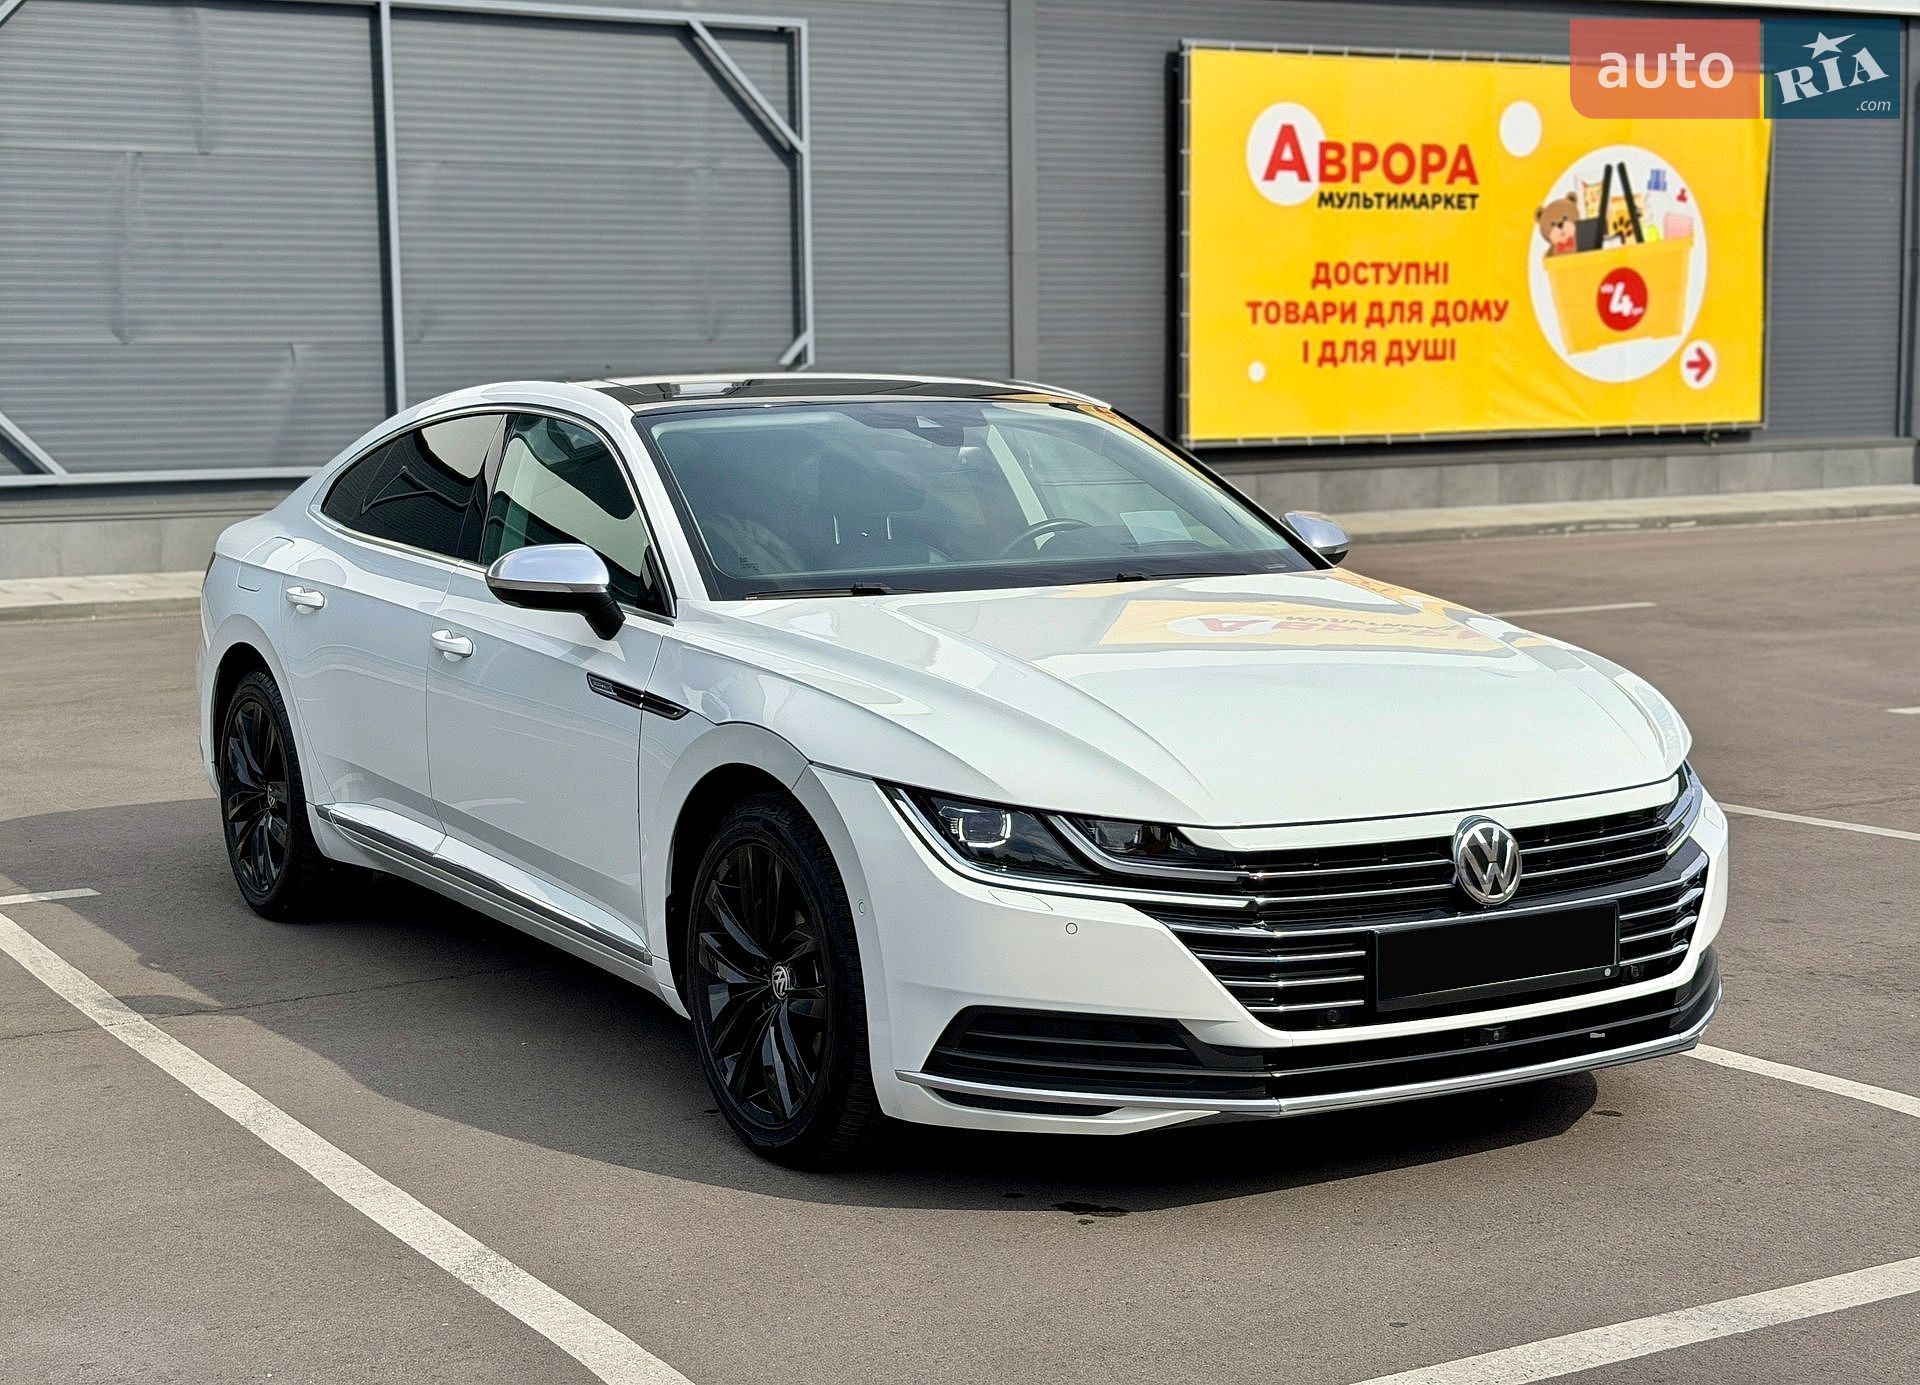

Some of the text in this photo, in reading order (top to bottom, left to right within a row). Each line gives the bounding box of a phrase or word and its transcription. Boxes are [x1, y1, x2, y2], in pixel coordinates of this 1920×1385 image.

[1262, 123, 1479, 186] АВРОРА
[1317, 191, 1480, 211] МУЛЬТИМАРКЕТ
[1311, 261, 1450, 290] ДОСТУПНІ
[1246, 299, 1510, 329] ТОВАРИ ДЛЯ ДОМУ
[1302, 338, 1456, 368] І ДЛЯ ДУШІ
